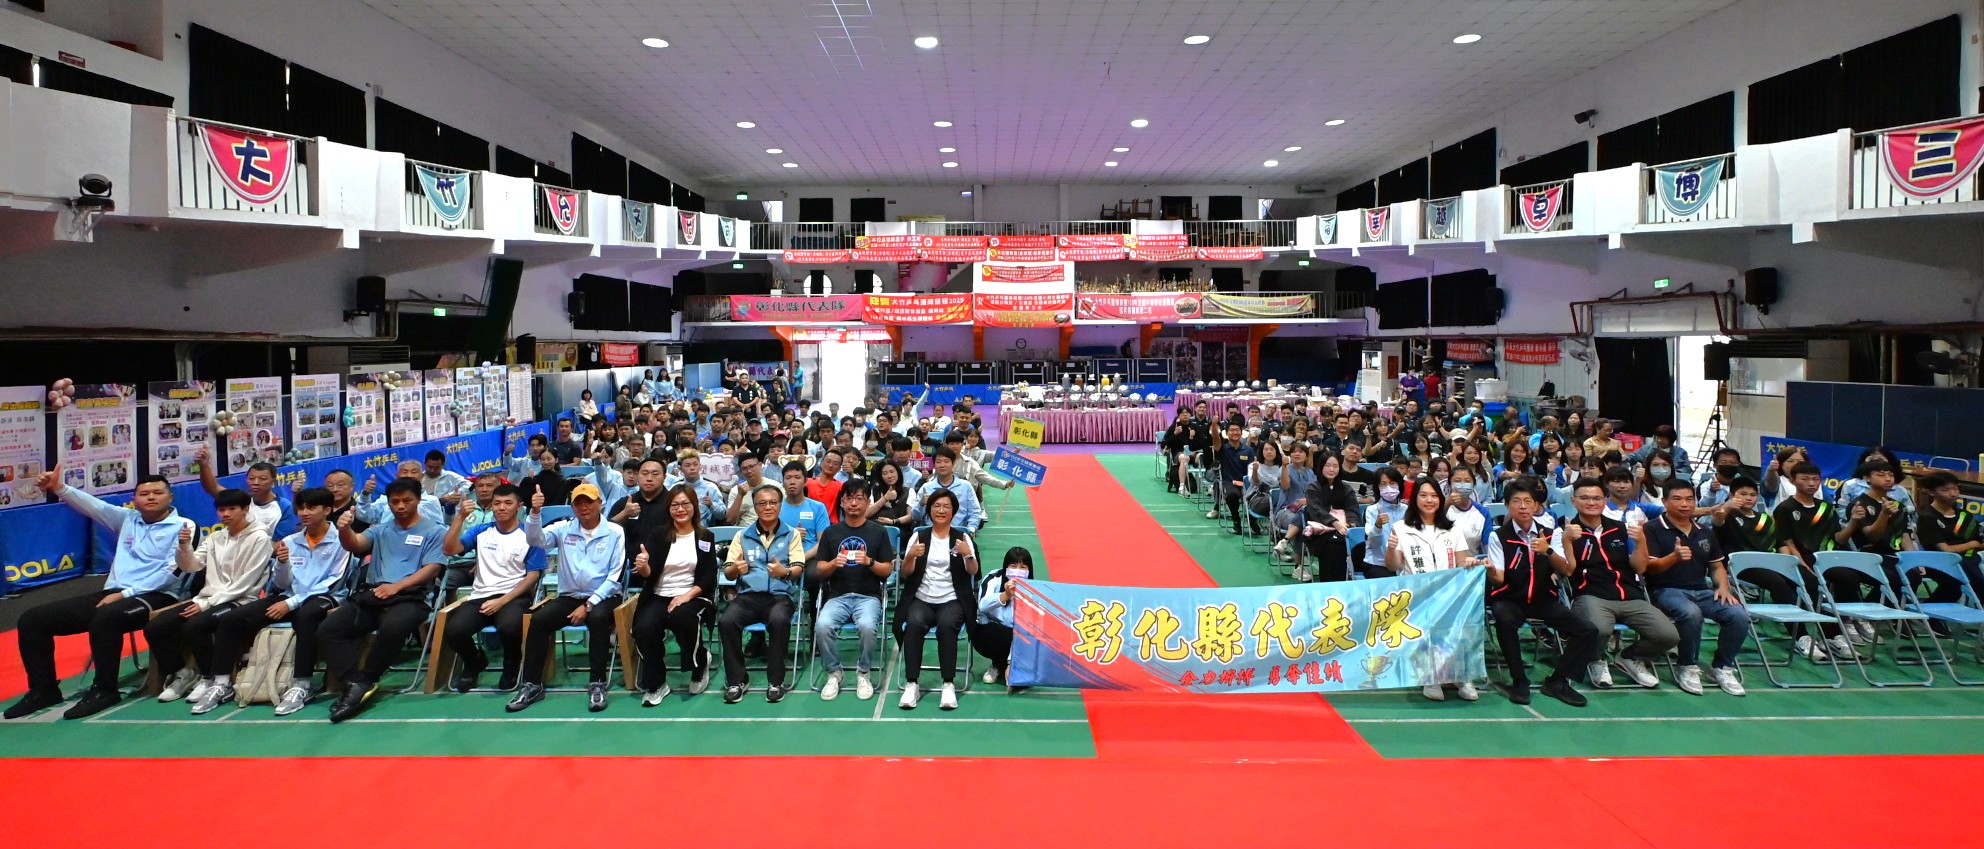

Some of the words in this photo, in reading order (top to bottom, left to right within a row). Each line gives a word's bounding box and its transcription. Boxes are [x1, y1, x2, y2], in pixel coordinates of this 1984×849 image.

[232, 138, 273, 185] 大
[1909, 129, 1962, 182] 三
[436, 177, 458, 207] 竹
[632, 206, 642, 226] 文
[756, 300, 845, 312] 彰化縣代表隊
[1013, 427, 1038, 439] 彰化縣
[446, 440, 469, 454] 大竹乒乓
[364, 453, 398, 469] 大竹乒乓
[997, 458, 1038, 483] 彰化縣
[276, 469, 306, 486] 竹乒乓
[5, 555, 74, 581] OOLA
[1072, 589, 1423, 664] 彰化縣代表隊
